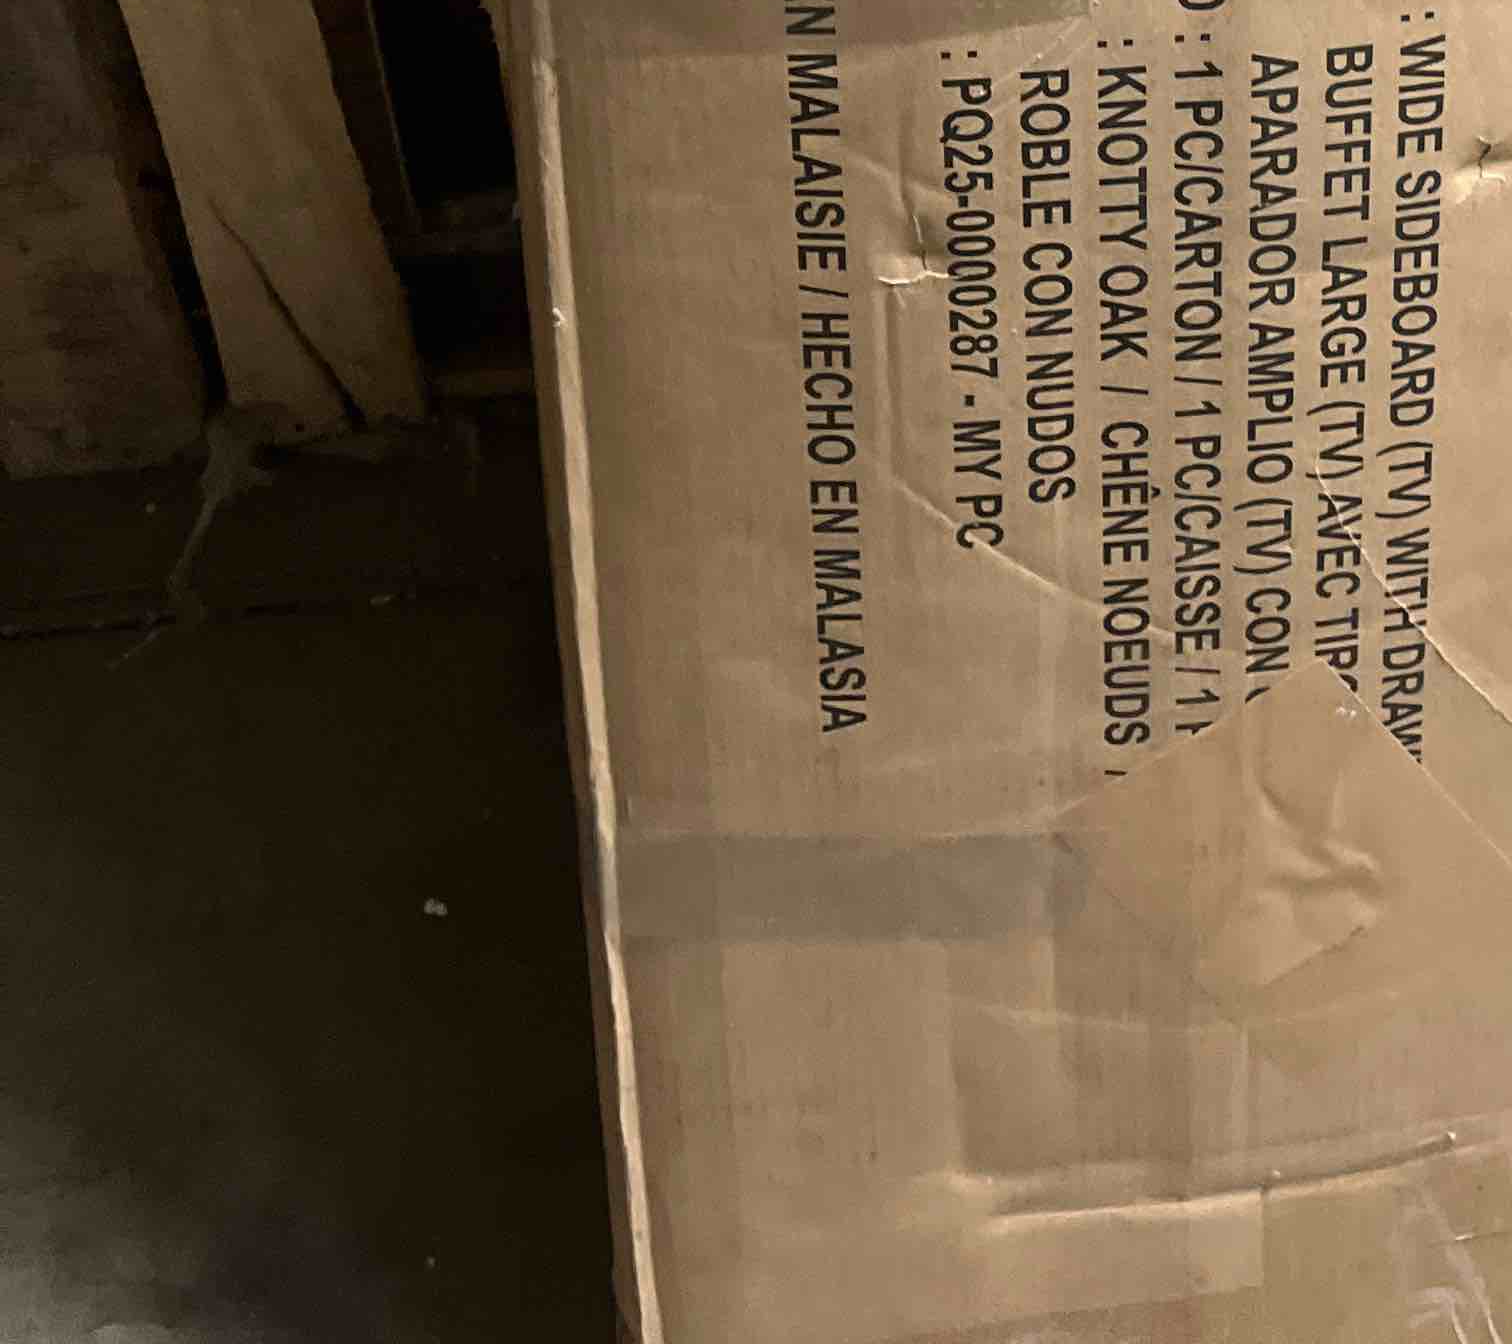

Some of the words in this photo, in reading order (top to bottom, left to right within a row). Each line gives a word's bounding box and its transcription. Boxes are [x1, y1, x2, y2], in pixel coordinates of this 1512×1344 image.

[1174, 60, 1224, 79] 1
[1396, 34, 1446, 158] WIDE
[786, 53, 847, 272] MALAISIE
[1019, 68, 1072, 228] ROBLE
[1097, 65, 1148, 251] KNOTTY
[1248, 53, 1300, 312] APARADOR
[1323, 43, 1374, 221] BUFFET
[939, 77, 999, 379] PQ25-0000287
[798, 284, 849, 299] /
[1022, 242, 1073, 338] CON
[1098, 264, 1149, 361] OAK
[1319, 236, 1369, 389] LARGE
[1389, 169, 1442, 427] SIDEBOARD
[800, 312, 857, 465] HECHO
[1025, 351, 1076, 503] NUDOS
[1099, 385, 1149, 396] /
[1173, 376, 1223, 386] /
[1174, 400, 1222, 418] 1
[1246, 322, 1295, 484] AMPLIO
[953, 419, 1002, 481] MY
[1100, 421, 1161, 566] CHÊNE
[1305, 400, 1366, 481] (TV)
[1374, 441, 1434, 520] (TV)
[809, 480, 860, 534] EN
[955, 493, 1005, 549] PC
[1233, 497, 1293, 575] (TV)
[1315, 493, 1363, 599] AVEC
[1244, 587, 1292, 674] CON
[1383, 527, 1430, 633] WITH
[813, 549, 867, 733] MALASIA
[1102, 577, 1151, 745] NOEUDS
[1174, 667, 1221, 675] /
[1175, 688, 1221, 705] 1
[1381, 642, 1426, 767] DRAW
